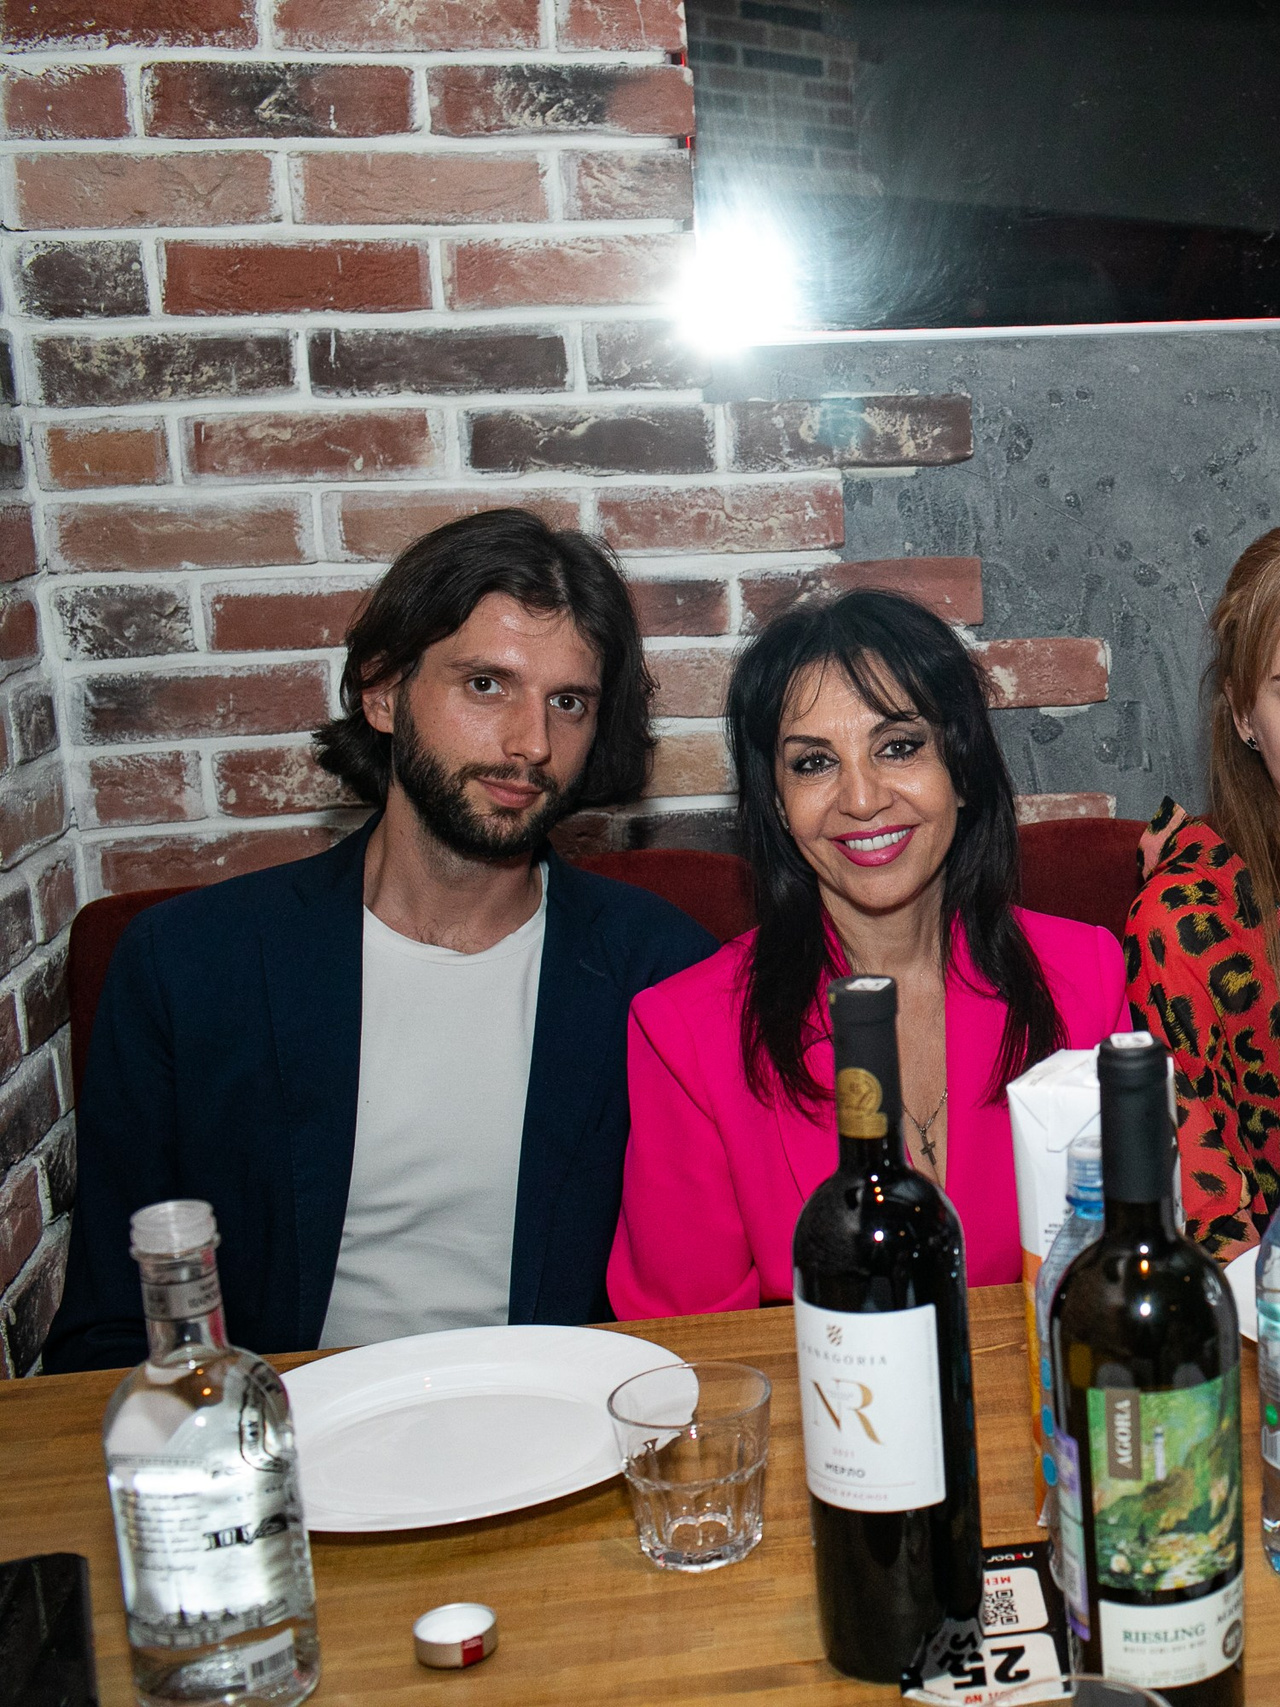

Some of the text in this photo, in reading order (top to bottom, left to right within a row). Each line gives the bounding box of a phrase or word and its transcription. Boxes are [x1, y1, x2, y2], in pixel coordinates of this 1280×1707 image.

[1114, 1399, 1134, 1468] AGORA
[1122, 1623, 1206, 1644] RIESLING
[953, 1645, 1031, 1690] 25
